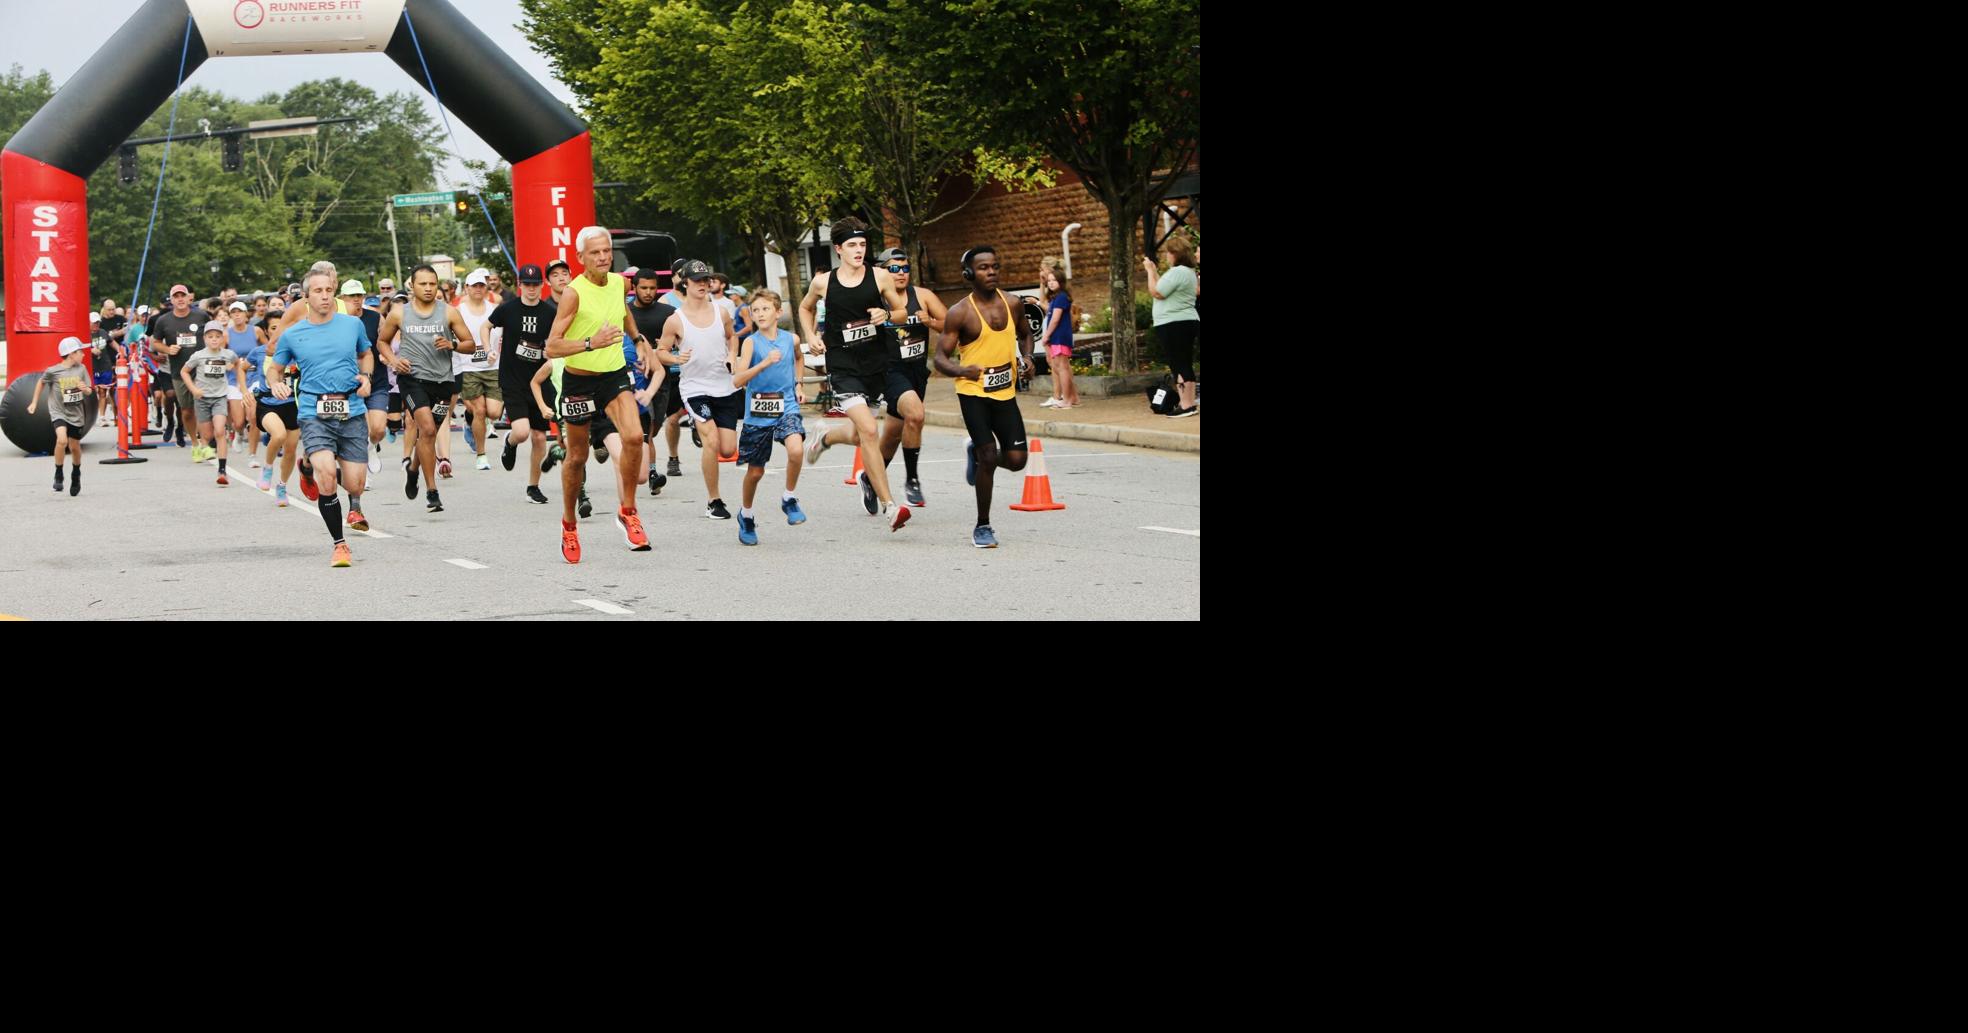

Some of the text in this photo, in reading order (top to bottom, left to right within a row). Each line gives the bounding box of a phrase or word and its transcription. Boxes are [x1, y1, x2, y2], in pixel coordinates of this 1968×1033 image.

[269, 0, 361, 12] RUNNERS FIT
[269, 14, 362, 22] RACEWORKS
[551, 186, 571, 263] FINI
[30, 205, 60, 328] START
[405, 324, 445, 334] VENEZUELA
[850, 327, 869, 340] 775
[522, 347, 537, 358] 755
[907, 345, 921, 356] 752
[988, 371, 1010, 386] 2389
[323, 401, 344, 412] 663
[566, 402, 589, 415] 669
[754, 400, 780, 411] 2384
